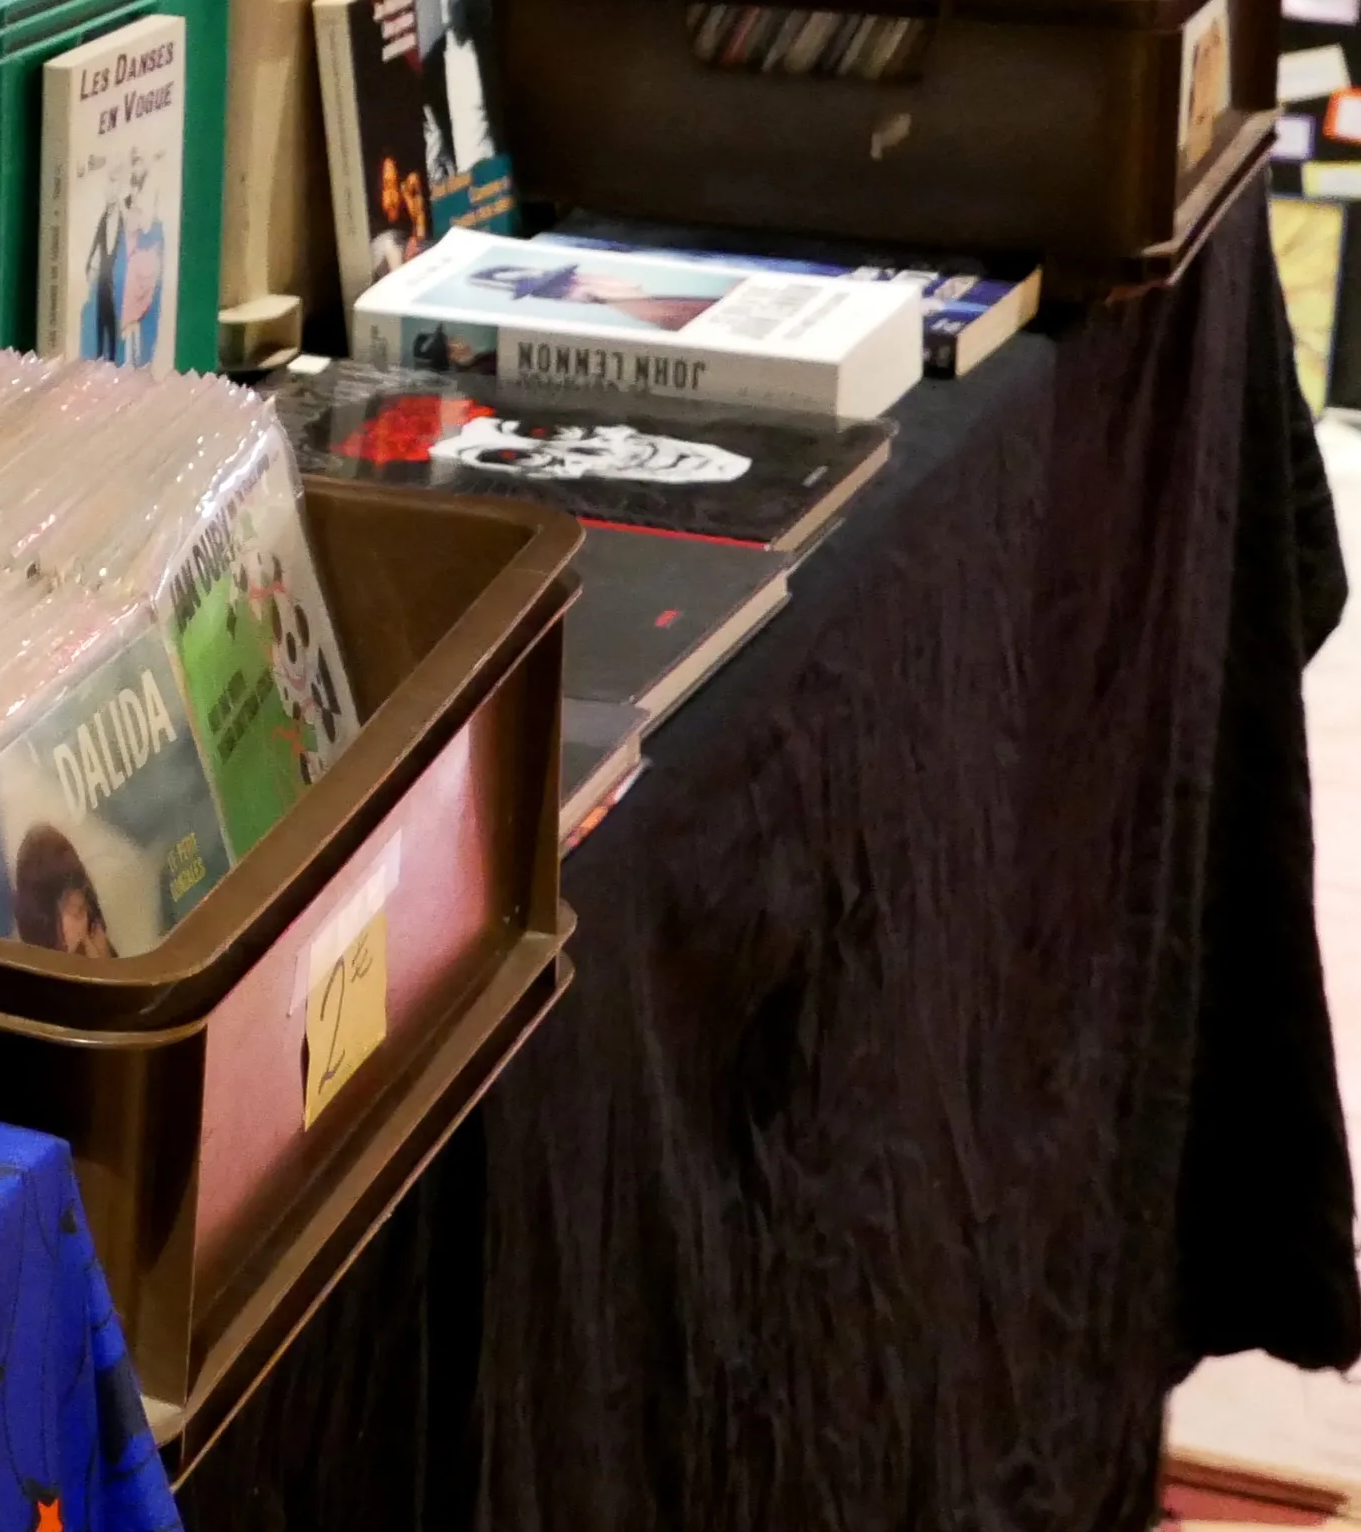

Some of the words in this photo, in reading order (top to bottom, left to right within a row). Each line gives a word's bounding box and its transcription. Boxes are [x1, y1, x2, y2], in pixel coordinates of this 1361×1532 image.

[517, 341, 624, 381] LENNON
[635, 353, 707, 390] JOHN
[53, 669, 177, 820] DALIDA
